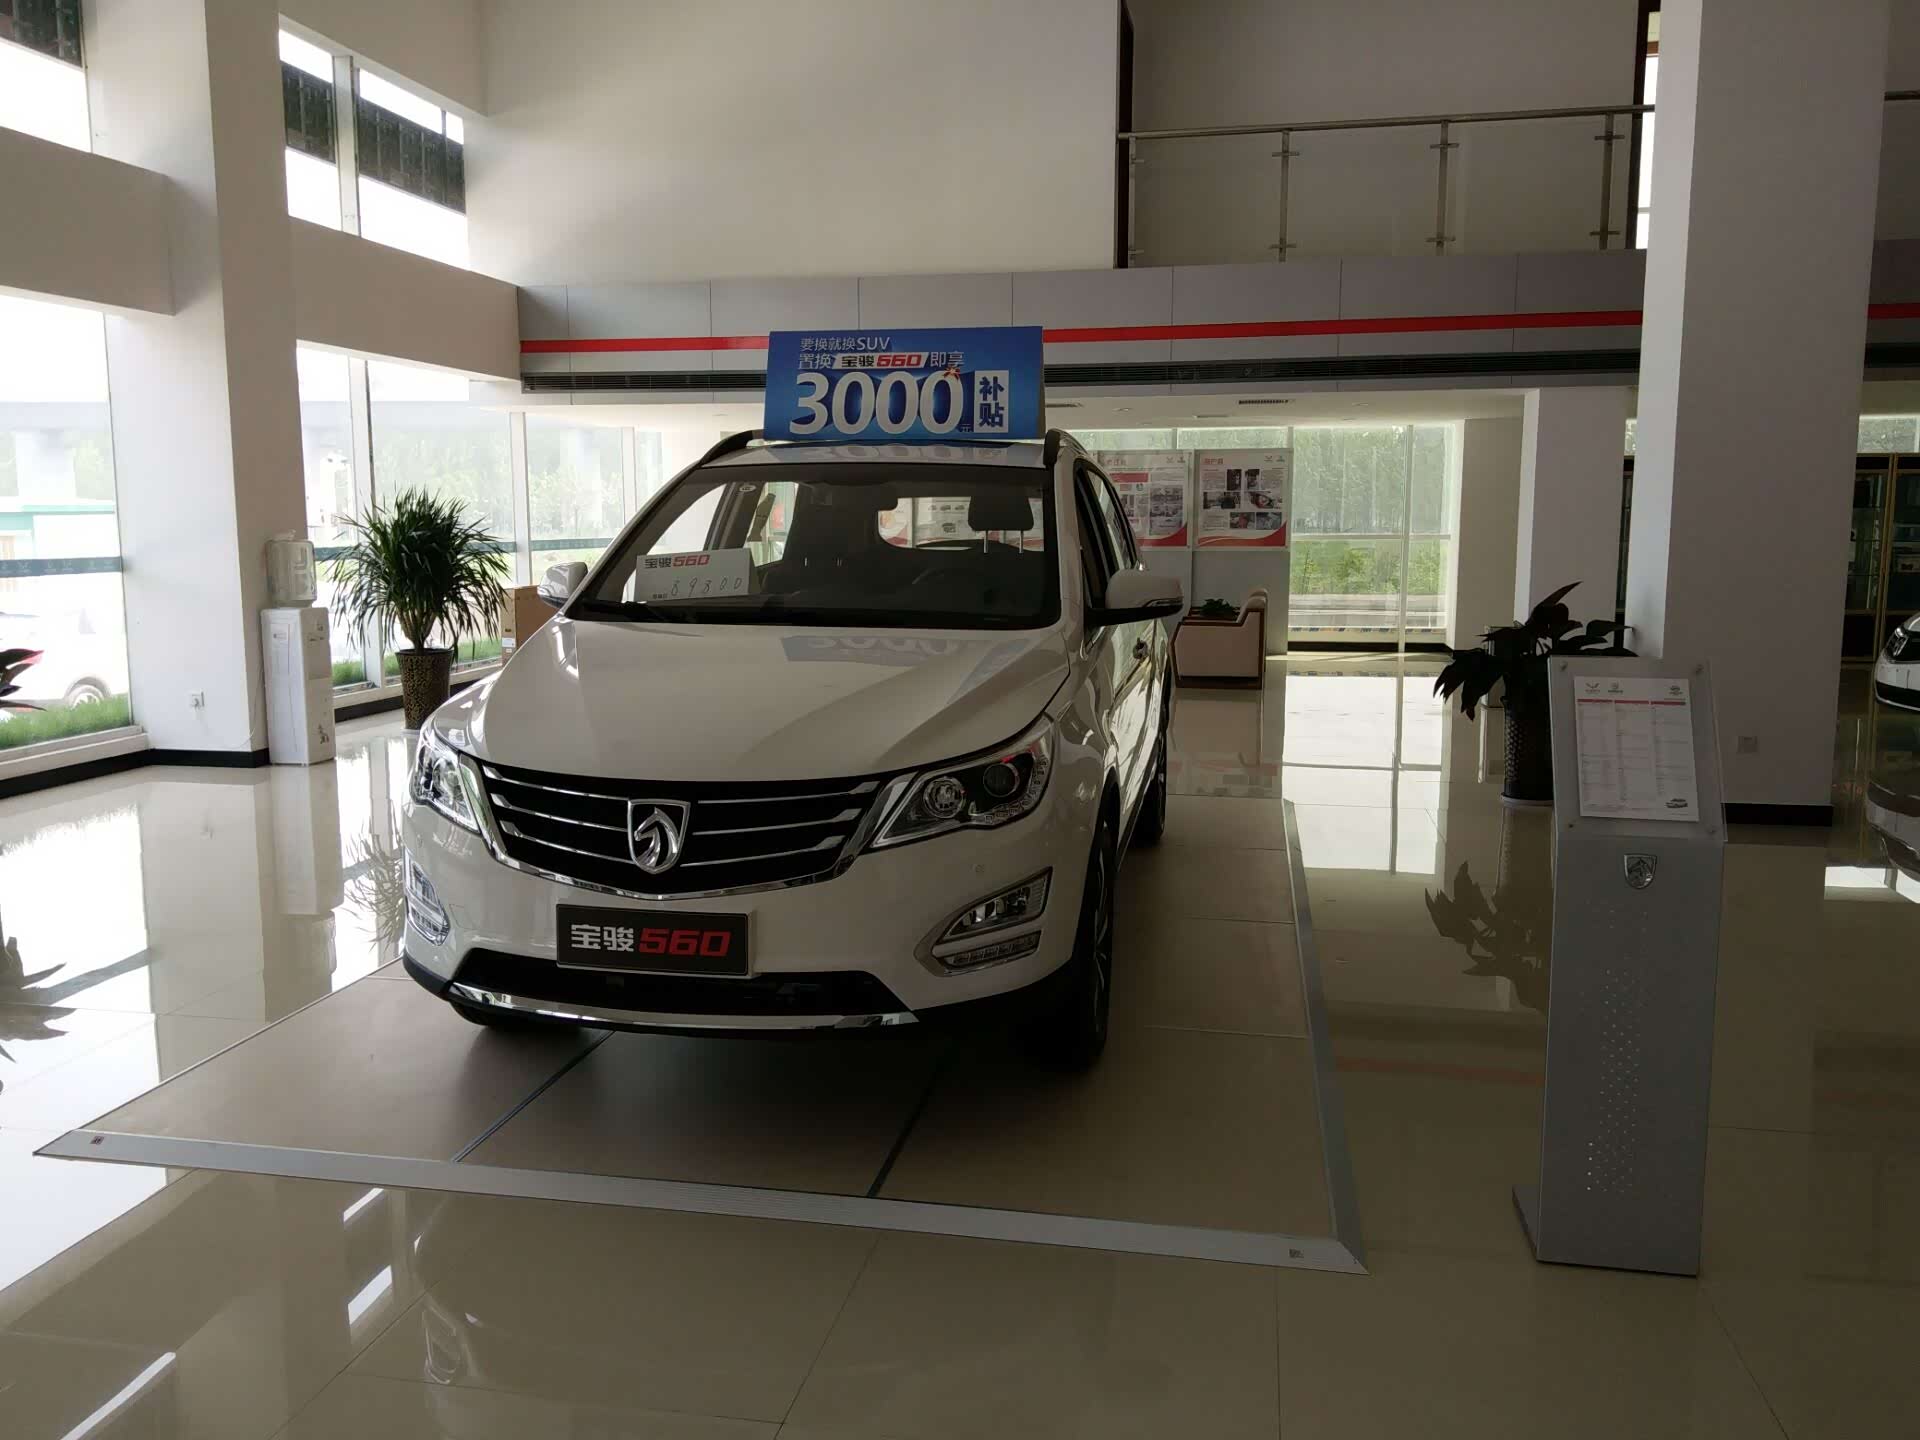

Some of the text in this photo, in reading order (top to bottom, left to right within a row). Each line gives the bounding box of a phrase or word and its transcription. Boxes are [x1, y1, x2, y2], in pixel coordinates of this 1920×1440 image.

[800, 336, 890, 351] 要换就换SUV
[789, 370, 964, 434] 3000
[978, 376, 1005, 427] 补贴
[571, 924, 732, 957] 宝骏560
